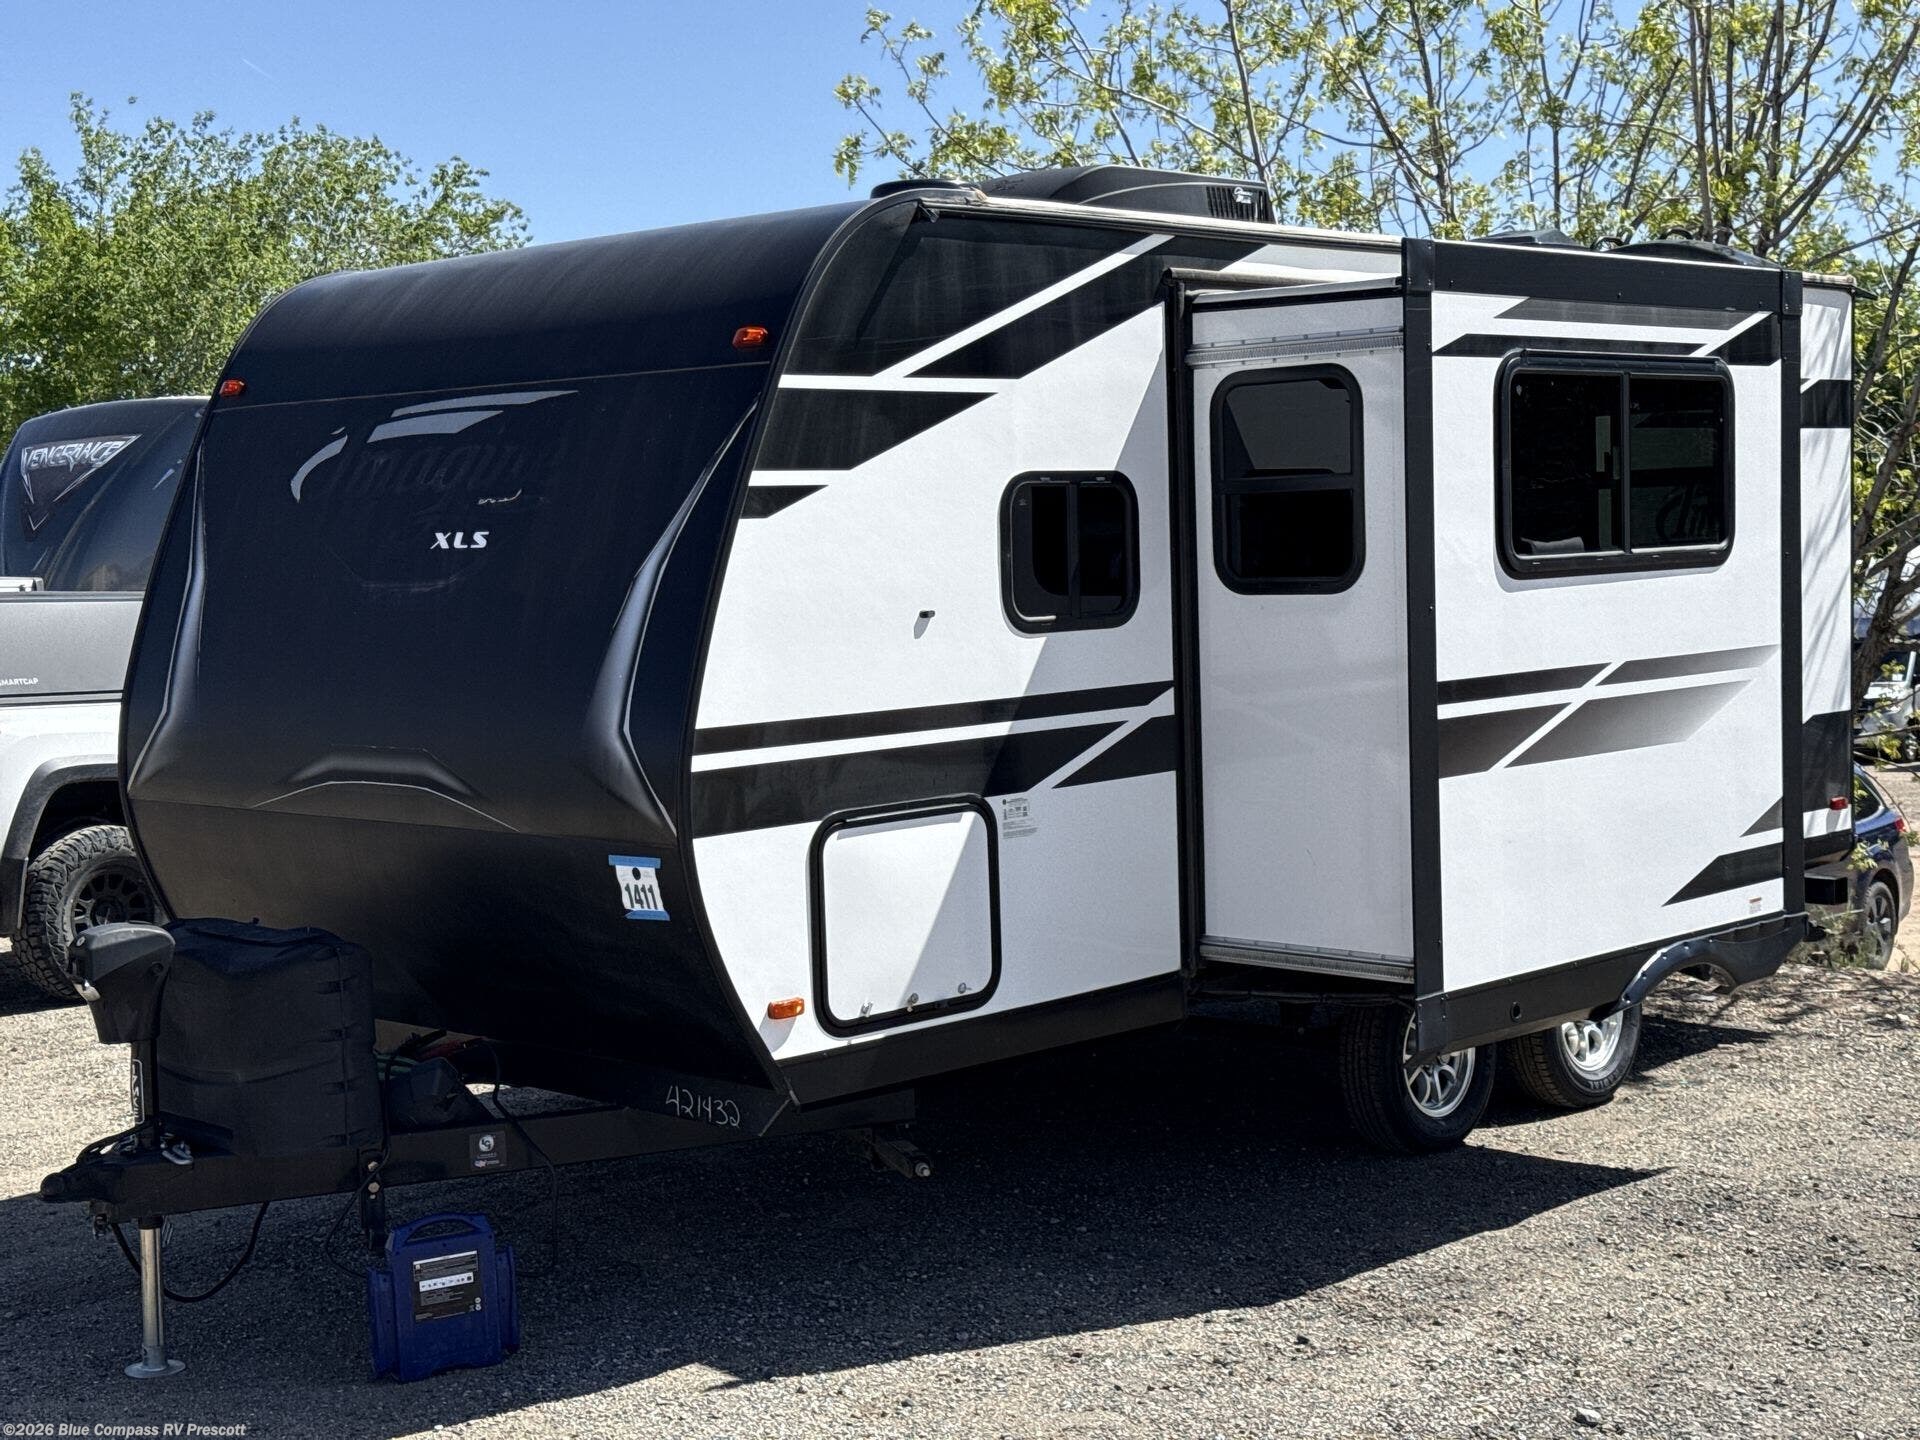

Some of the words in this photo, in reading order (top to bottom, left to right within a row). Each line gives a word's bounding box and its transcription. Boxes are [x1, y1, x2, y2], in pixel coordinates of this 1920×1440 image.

[21, 440, 128, 472] VENGEANCE
[430, 531, 490, 550] XLS
[0, 677, 39, 686] MARTCAP
[624, 883, 659, 910] 1411
[665, 1085, 741, 1129] 421432
